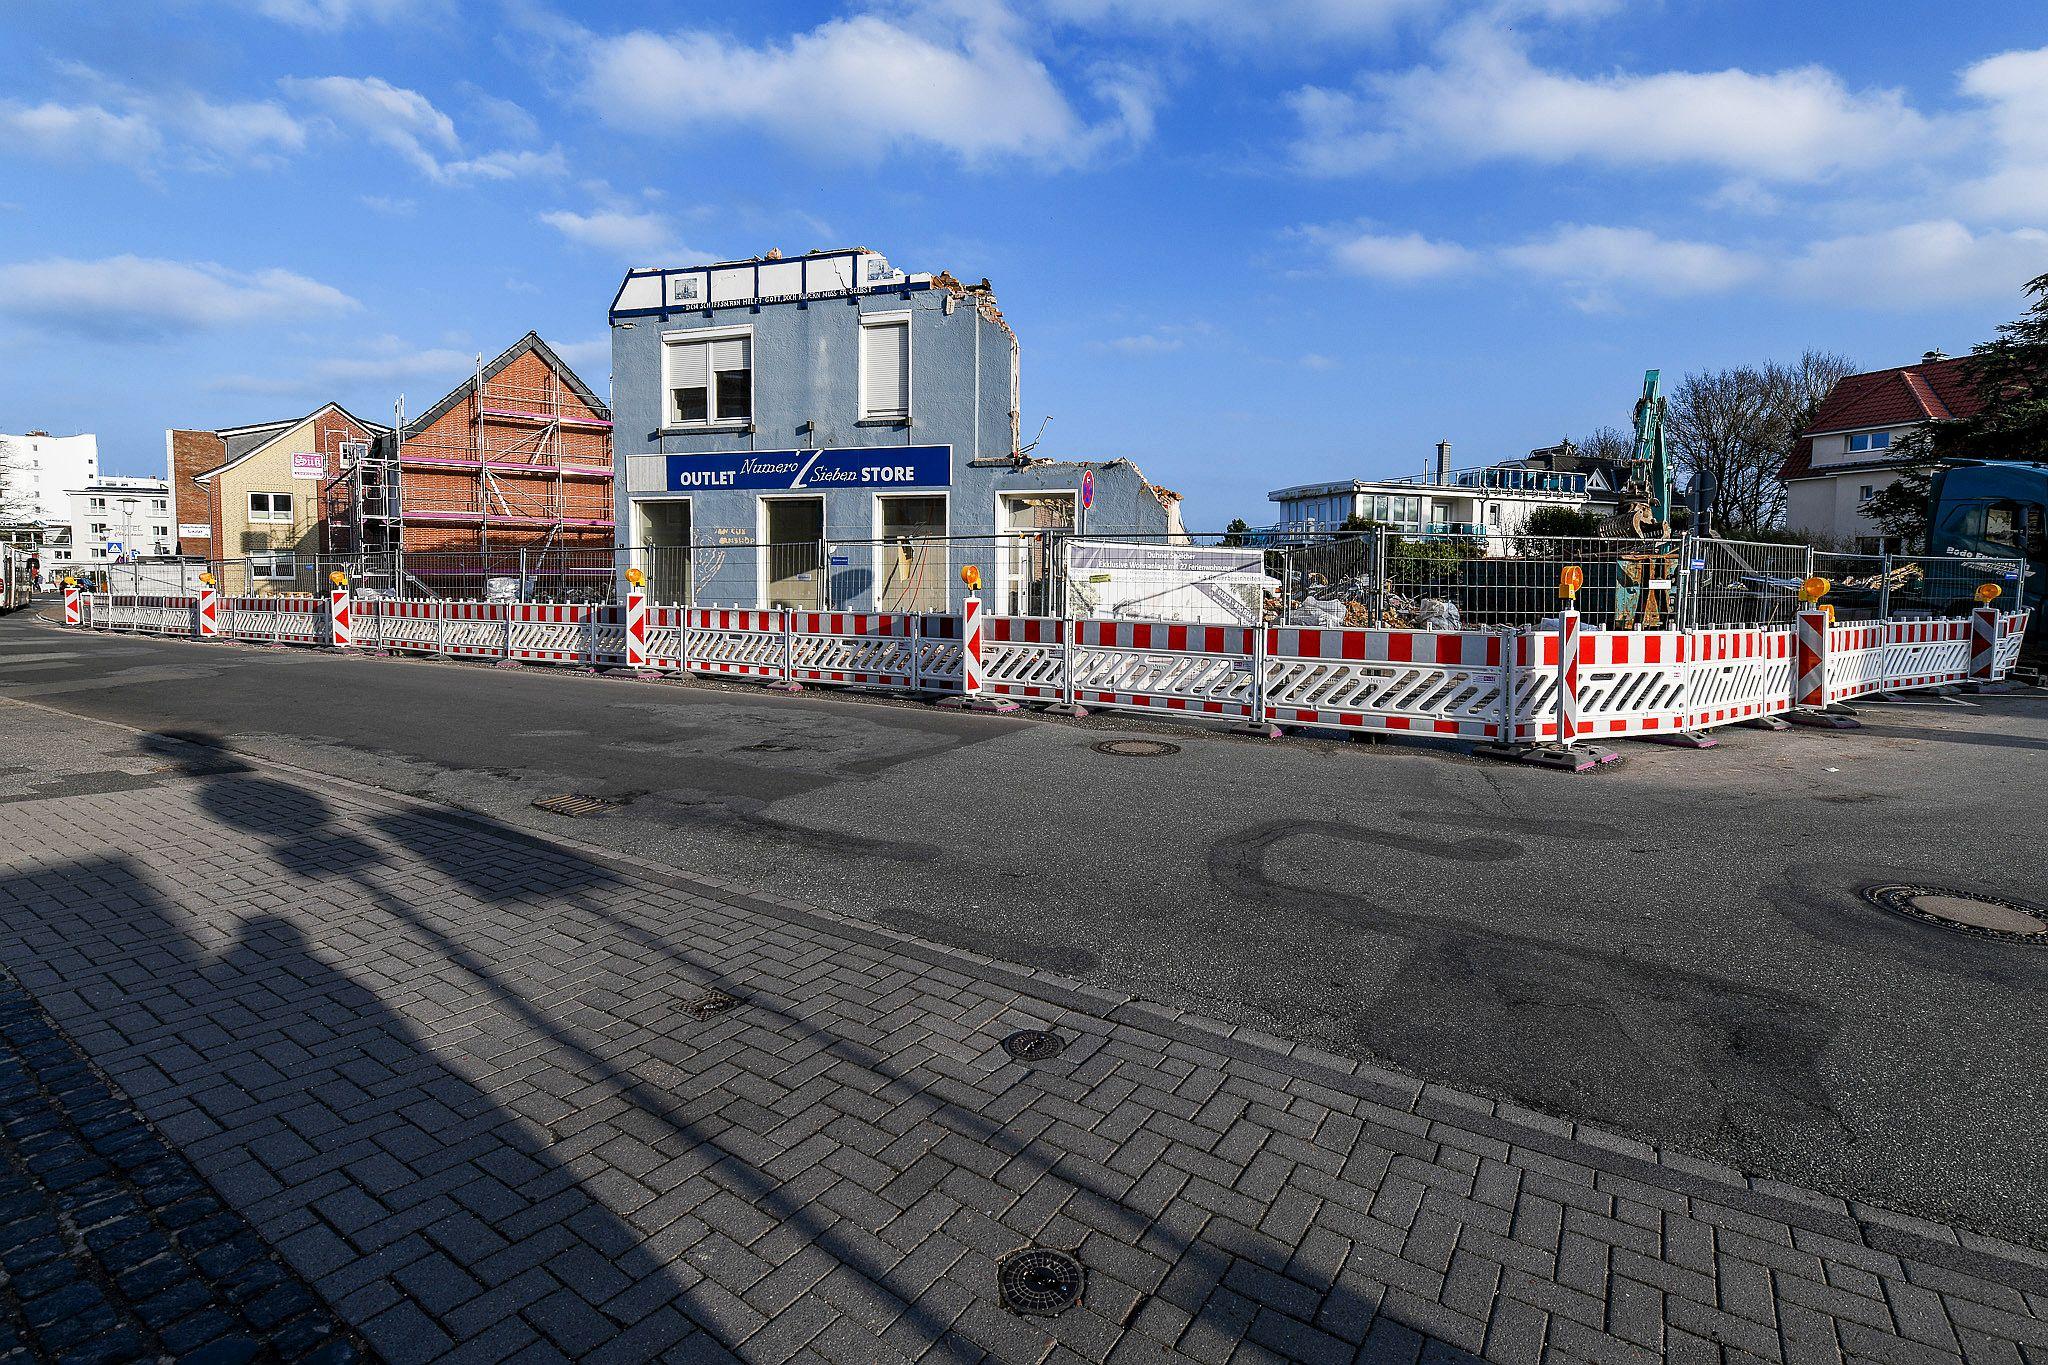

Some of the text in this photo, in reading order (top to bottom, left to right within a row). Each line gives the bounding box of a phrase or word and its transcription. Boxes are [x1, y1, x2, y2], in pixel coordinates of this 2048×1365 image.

[742, 297, 762, 306] HILFT
[822, 290, 838, 299] MUSS
[840, 289, 848, 297] ER
[680, 470, 736, 487] OUTLET
[739, 458, 799, 475] Numero
[809, 465, 858, 483] Sieben
[861, 466, 915, 483] STORE
[1946, 546, 1973, 559] Bodo
[1098, 560, 1238, 573] Exklusive Wohnanlage mit 27 Ferienwohnungen
